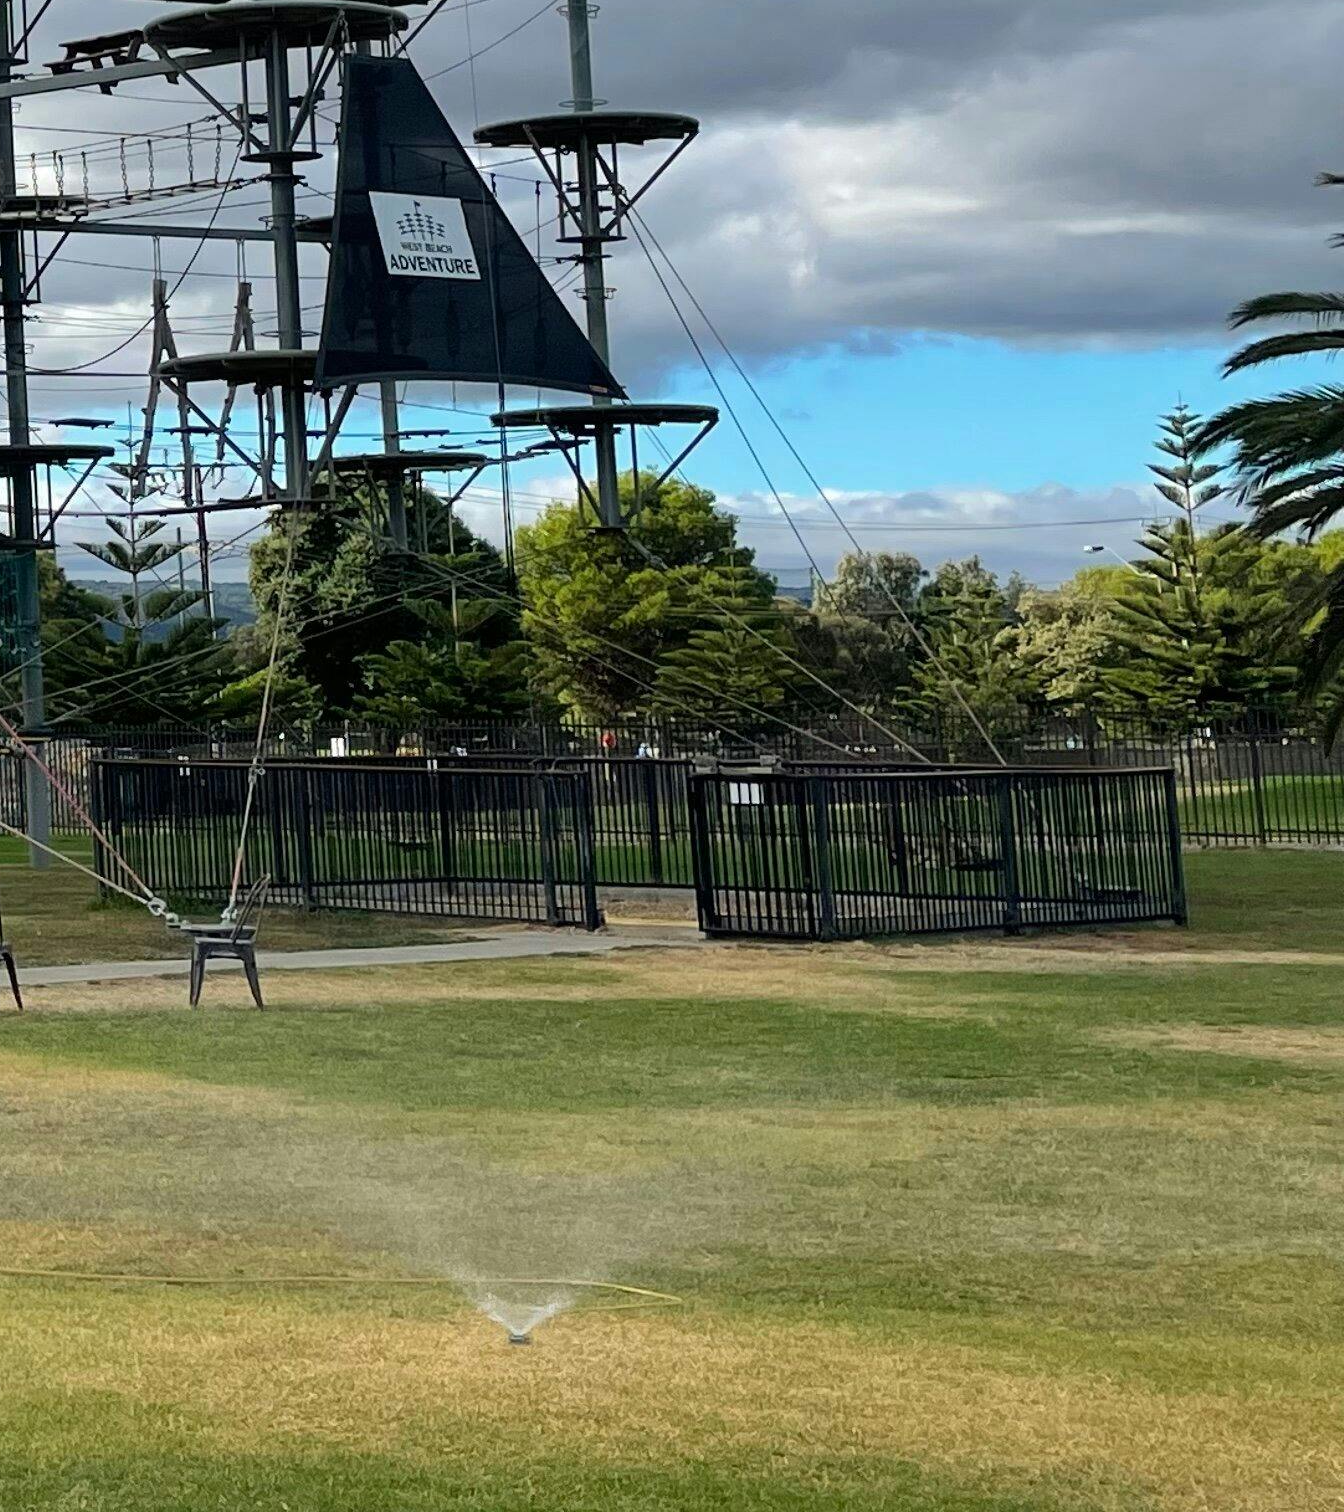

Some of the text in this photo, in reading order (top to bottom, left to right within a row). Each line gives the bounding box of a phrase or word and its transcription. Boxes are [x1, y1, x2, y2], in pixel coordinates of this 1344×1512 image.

[400, 242, 452, 253] WEST BEACH
[391, 254, 476, 274] ADVENTURE
